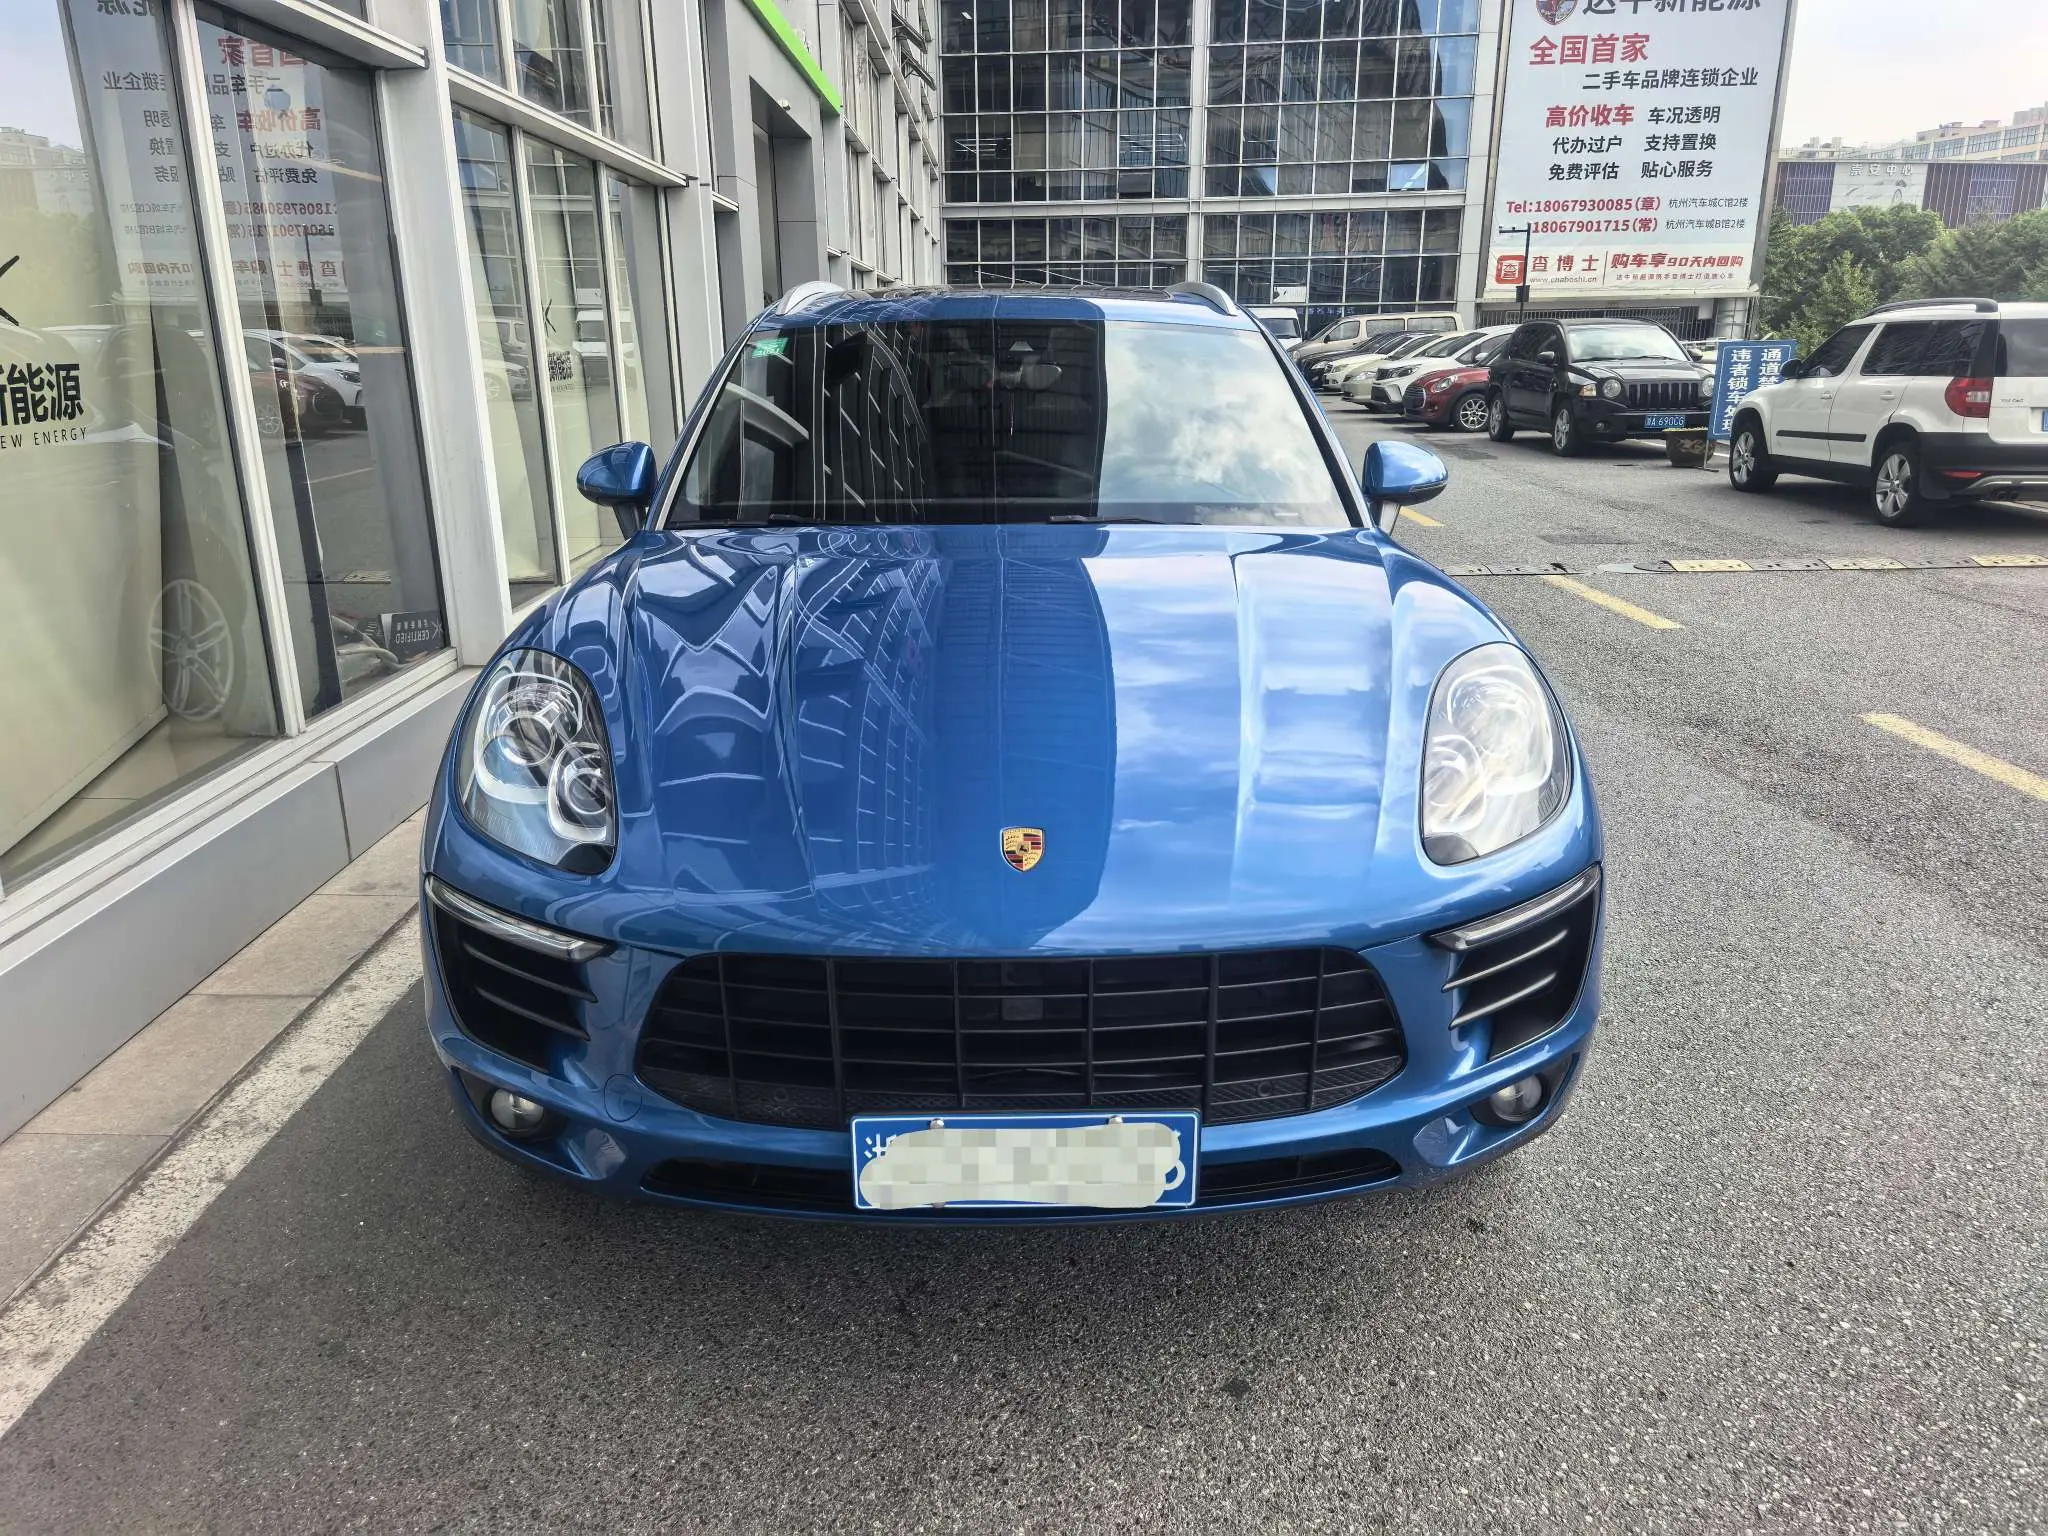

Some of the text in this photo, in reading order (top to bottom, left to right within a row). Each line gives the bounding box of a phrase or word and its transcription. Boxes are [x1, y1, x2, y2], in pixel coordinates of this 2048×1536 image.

[1529, 33, 1650, 66] 全国首家
[1582, 67, 1758, 90] 二手车品牌连锁企业
[1545, 104, 1721, 128] 高价收车 车况透明
[1552, 134, 1717, 154] 代办过户 支持置换
[1549, 159, 1713, 181] 免费评估 贴心服务
[1531, 217, 1657, 234] 18067901715(常)
[1531, 254, 1599, 272] 查博士
[0, 362, 84, 426] 能源
[33, 427, 87, 446] ENERGY
